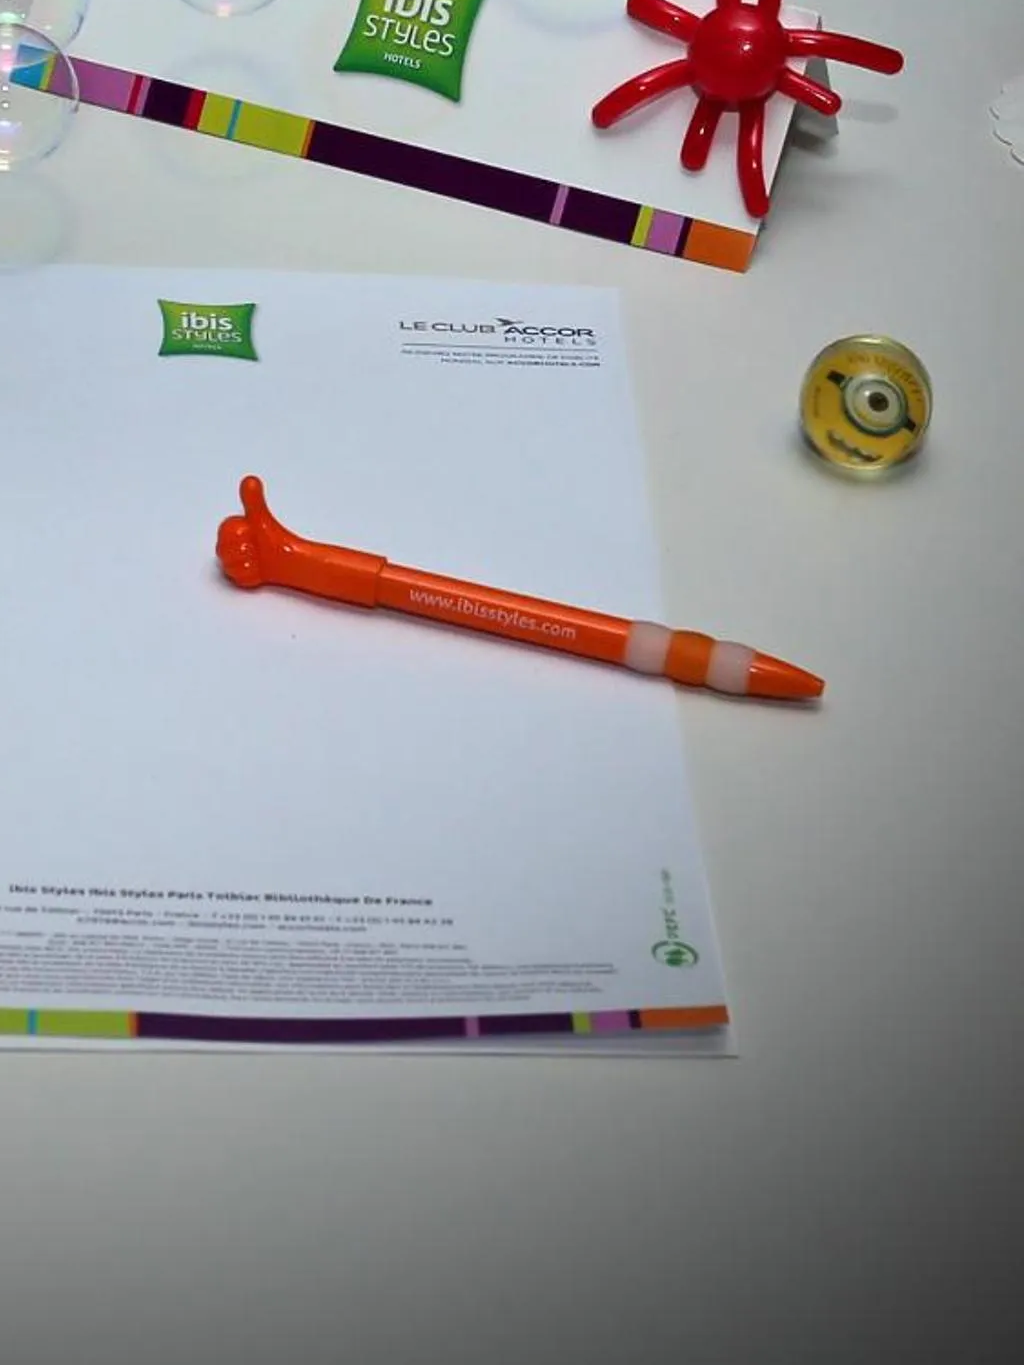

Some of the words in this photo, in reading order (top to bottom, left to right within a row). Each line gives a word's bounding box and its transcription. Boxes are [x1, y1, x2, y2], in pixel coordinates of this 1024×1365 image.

[383, 52, 423, 70] HOTELS
[180, 312, 233, 331] ibis
[399, 320, 426, 331] LE
[431, 322, 497, 334] CLUB
[503, 325, 596, 338] ACCOR
[504, 335, 597, 346] HOTELS
[409, 588, 577, 640] www.ibisstyles.com
